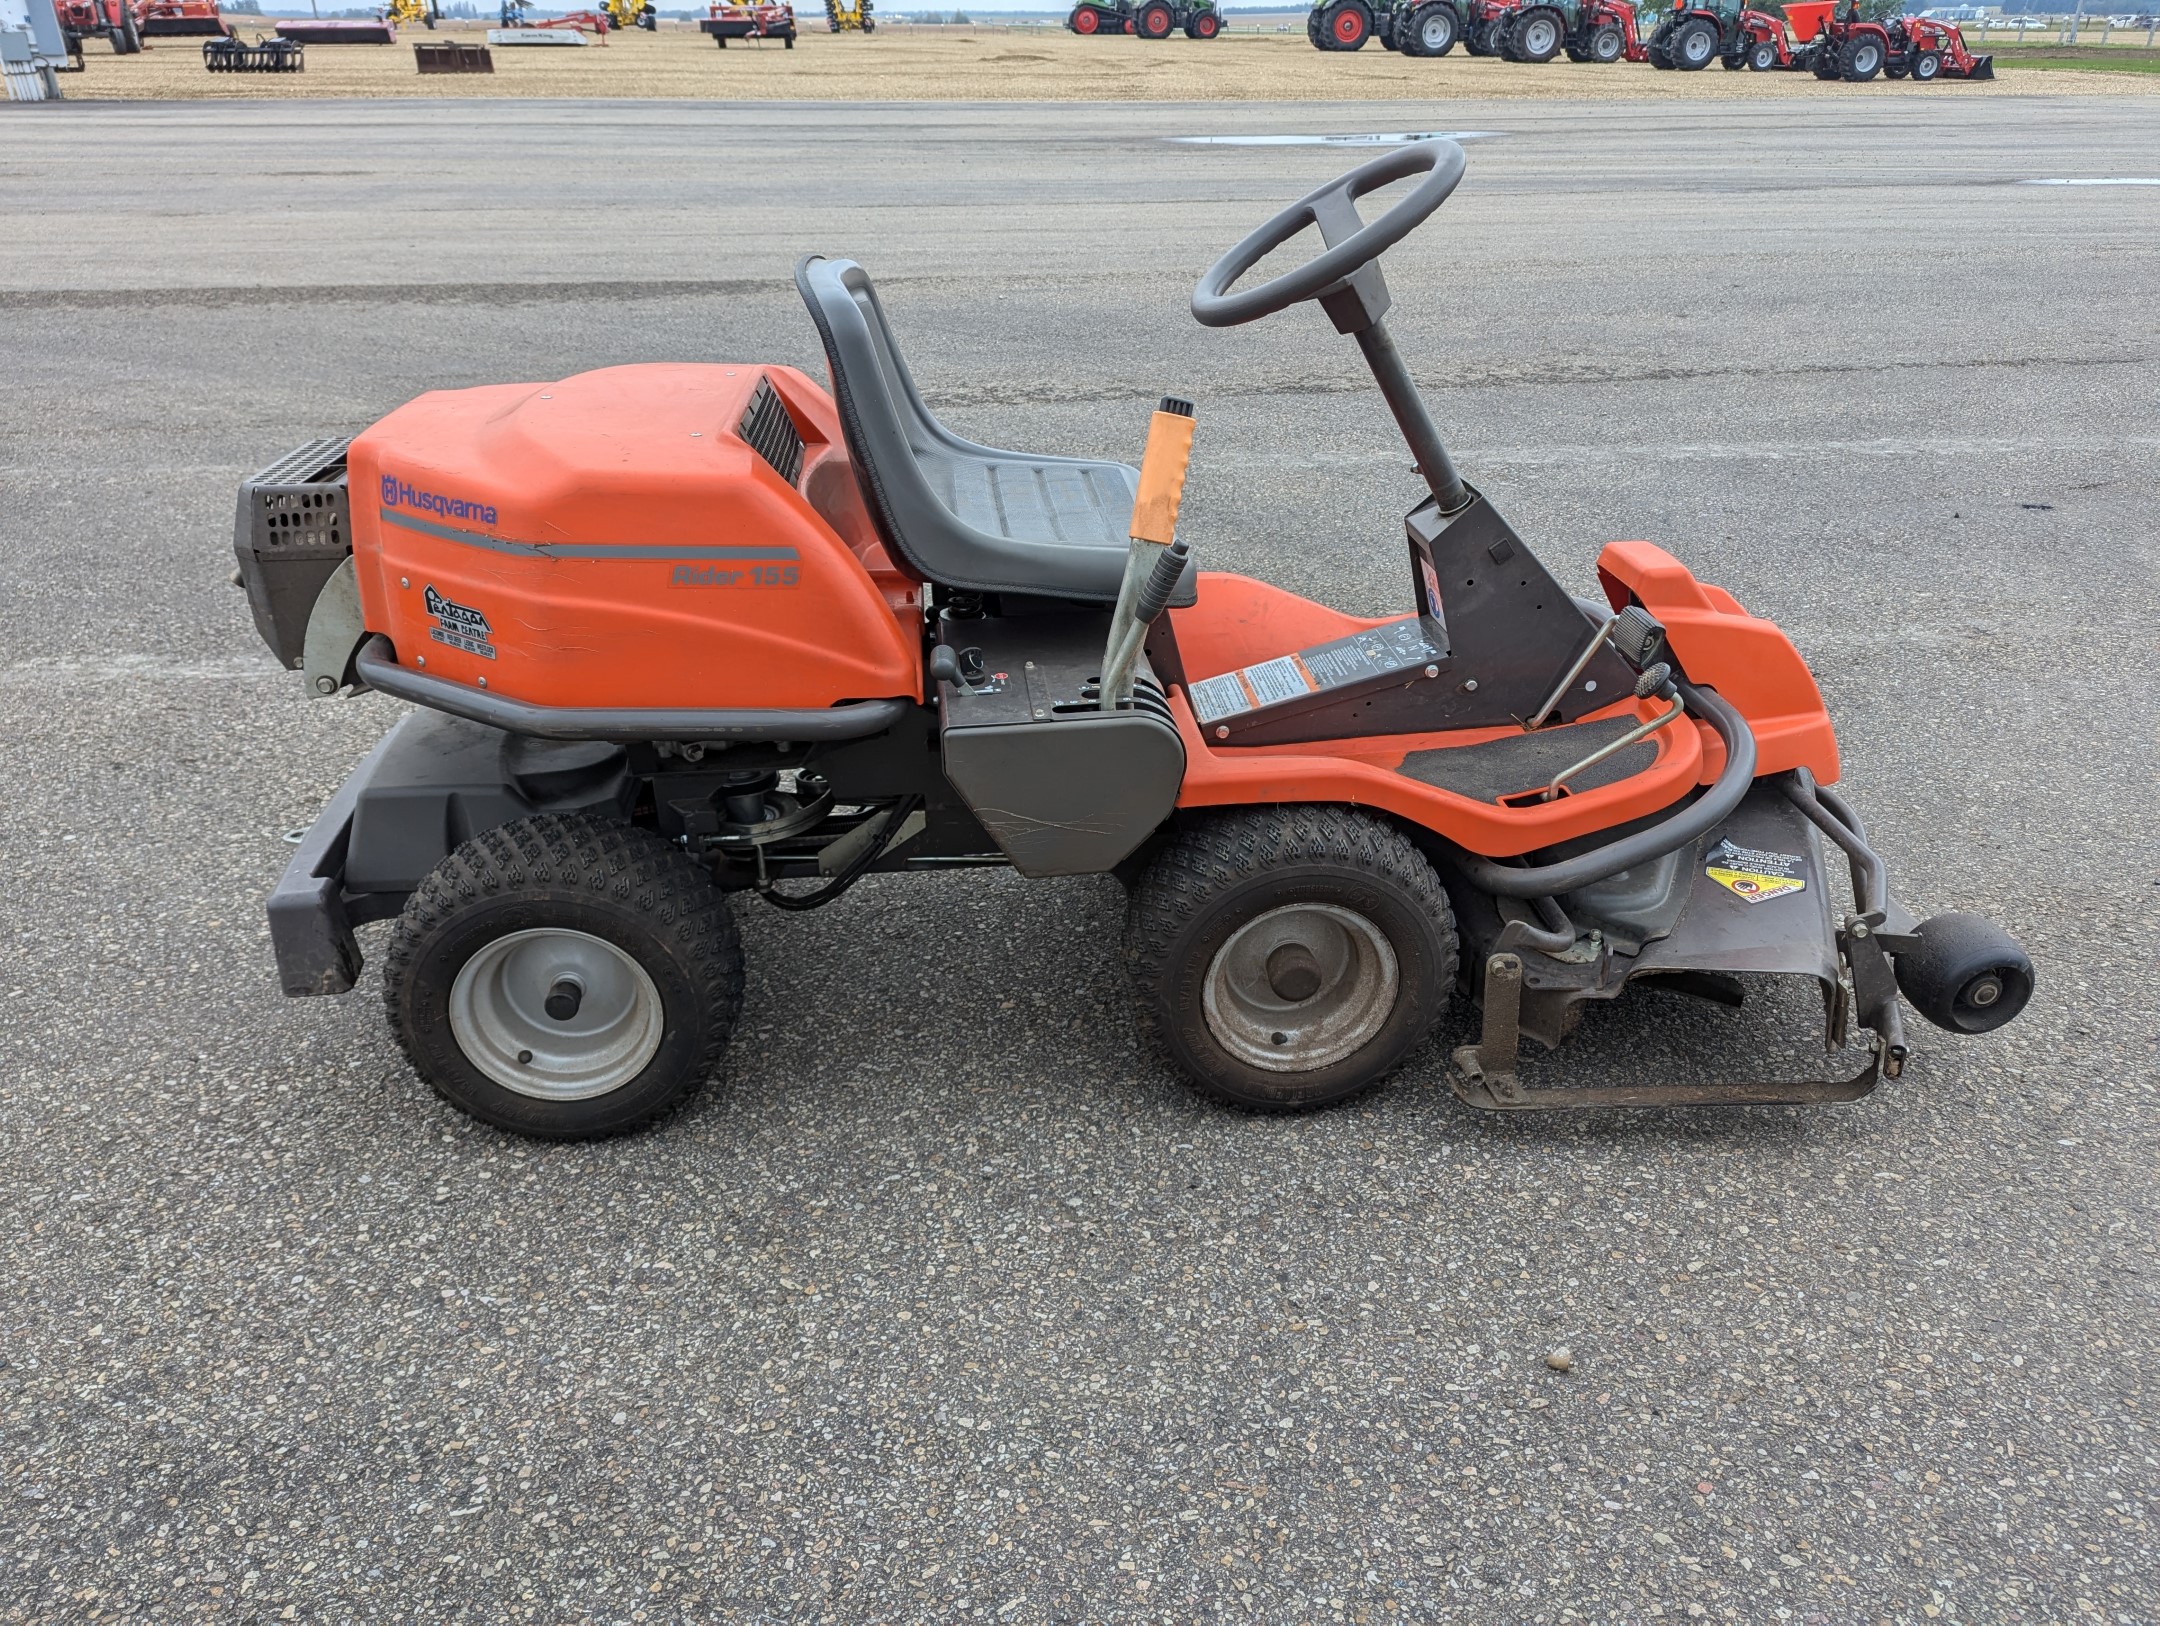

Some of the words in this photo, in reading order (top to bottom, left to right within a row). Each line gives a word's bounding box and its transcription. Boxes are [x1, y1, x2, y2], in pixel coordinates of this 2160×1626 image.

[399, 481, 497, 525] Husqvarna
[672, 565, 744, 585] Rider
[749, 566, 800, 586] 155
[440, 618, 460, 633] FARM
[1737, 855, 1791, 867] ATTENTION
[1741, 866, 1785, 877] CAUTION
[1750, 885, 1791, 901] DANGER
